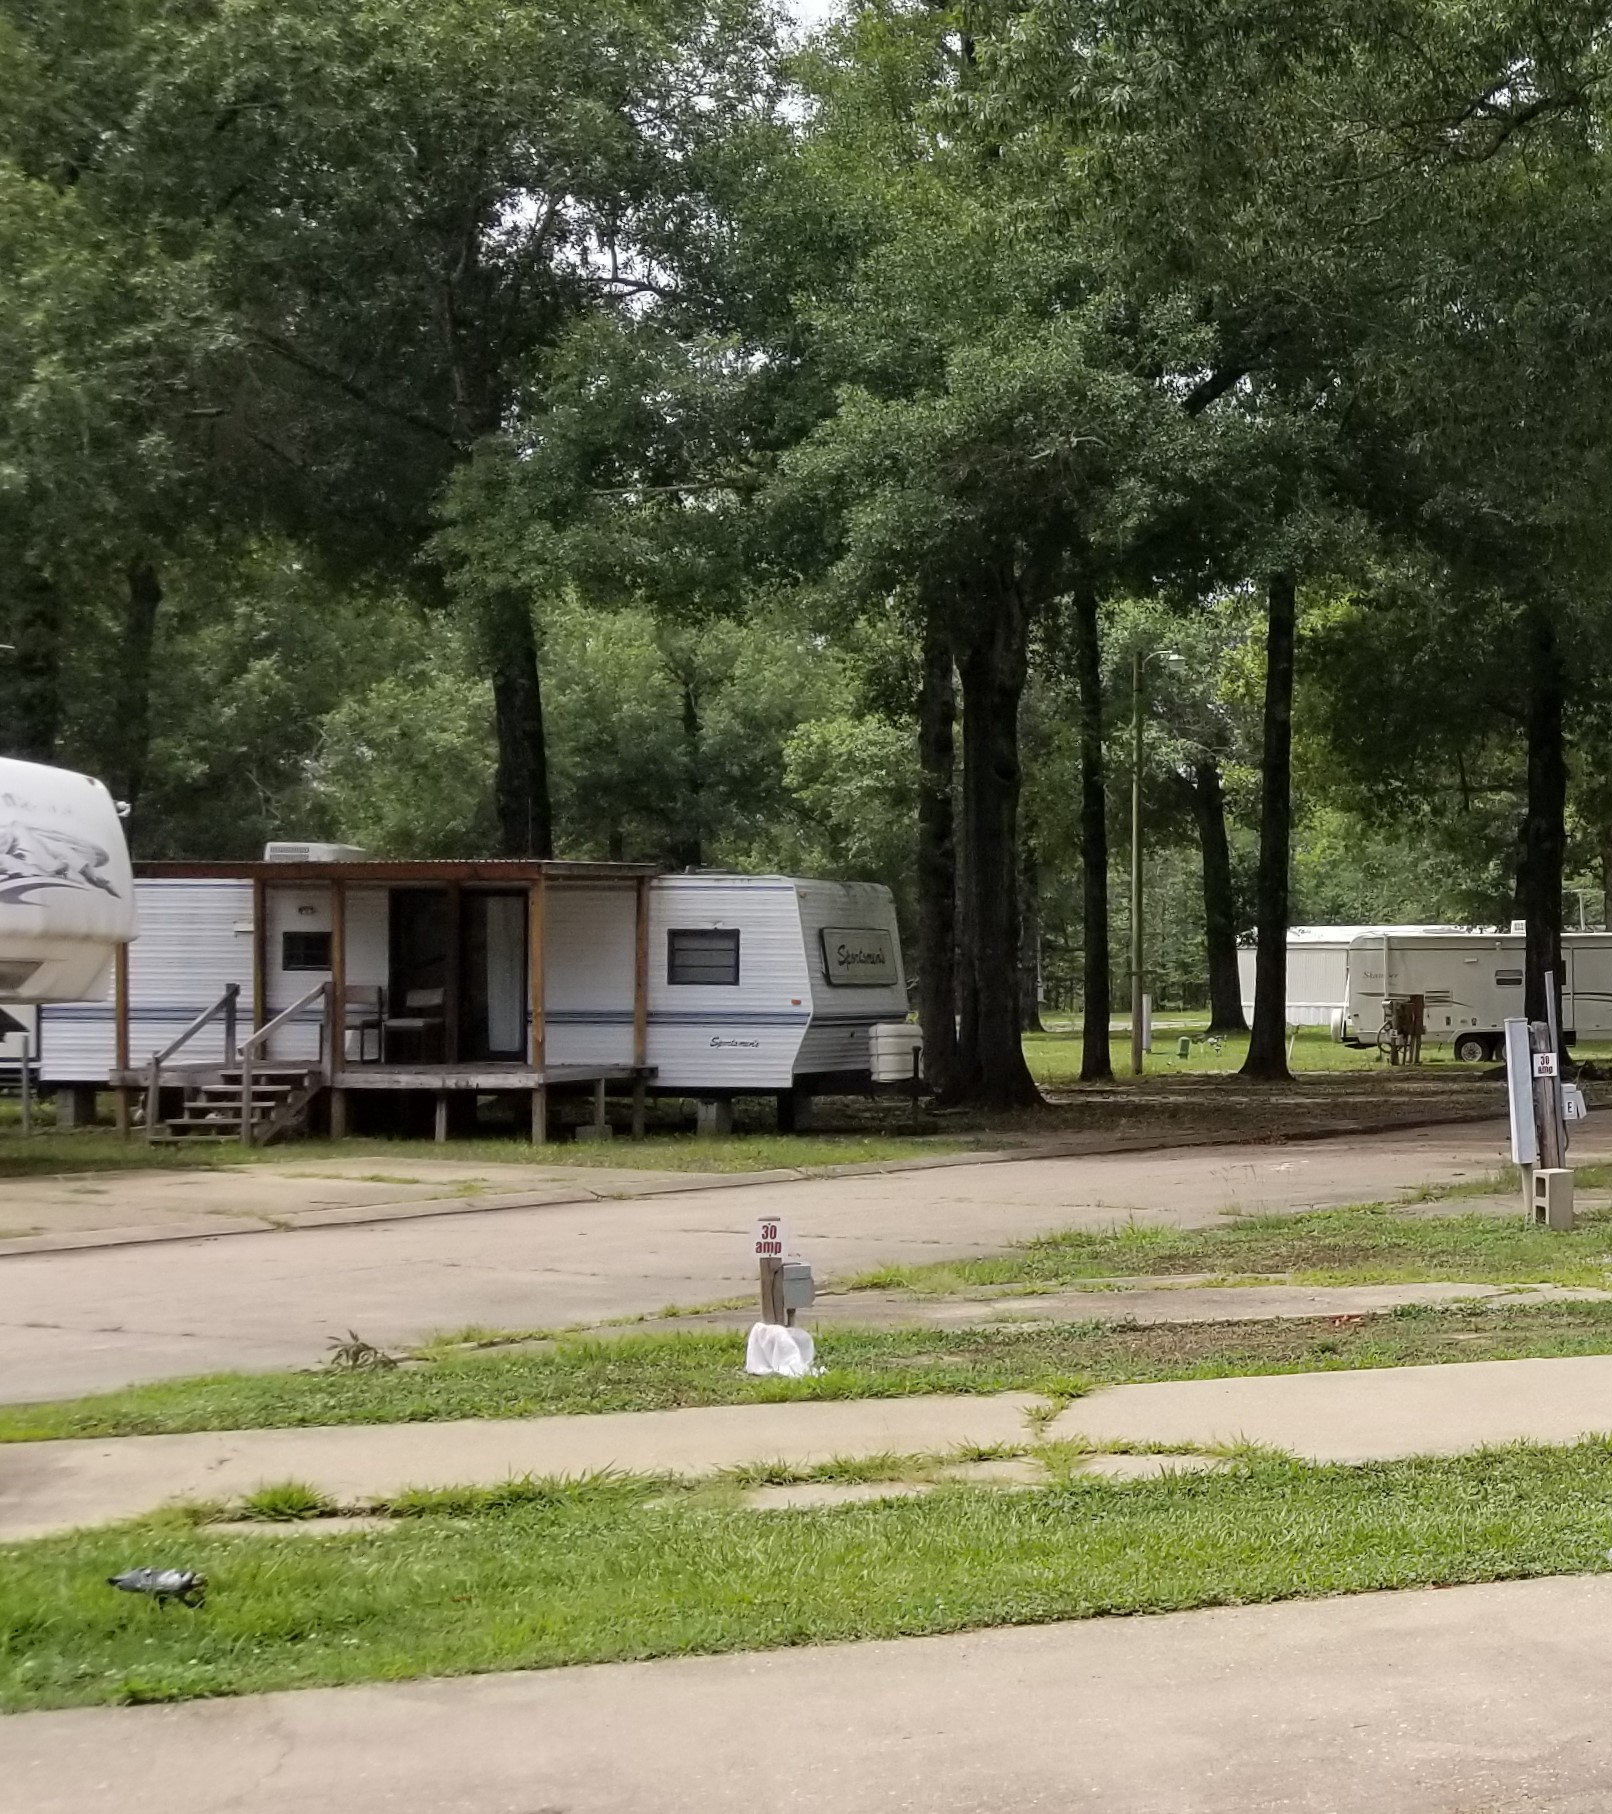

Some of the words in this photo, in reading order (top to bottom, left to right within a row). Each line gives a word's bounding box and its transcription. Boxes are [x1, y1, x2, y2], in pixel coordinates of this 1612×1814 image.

[1540, 1056, 1550, 1066] 30
[1567, 1101, 1573, 1113] E
[761, 1225, 777, 1240] 30
[755, 1241, 782, 1255] amp
